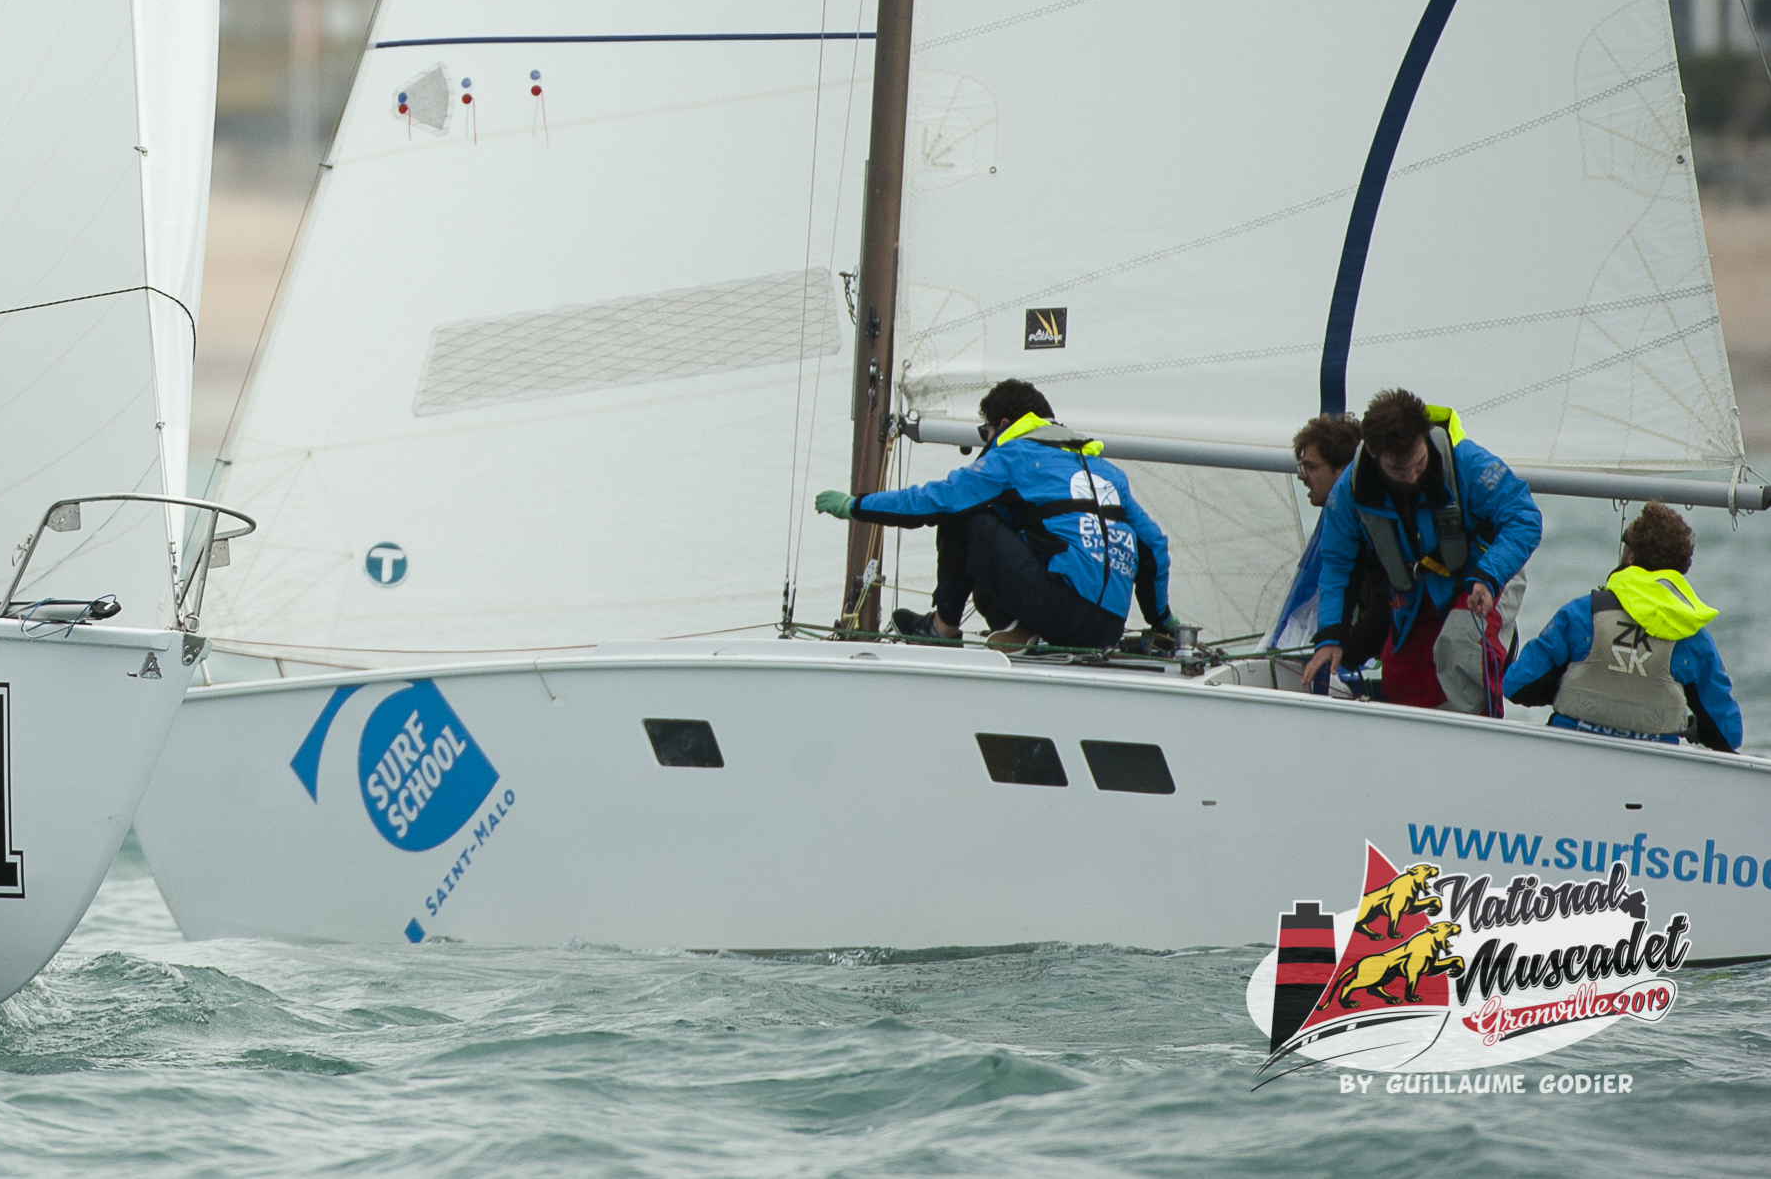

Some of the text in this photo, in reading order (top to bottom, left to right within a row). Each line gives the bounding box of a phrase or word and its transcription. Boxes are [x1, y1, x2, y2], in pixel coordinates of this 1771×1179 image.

[367, 708, 427, 810] SURF
[387, 725, 467, 839] SCHOOL
[425, 789, 515, 916] SAINT-MALO
